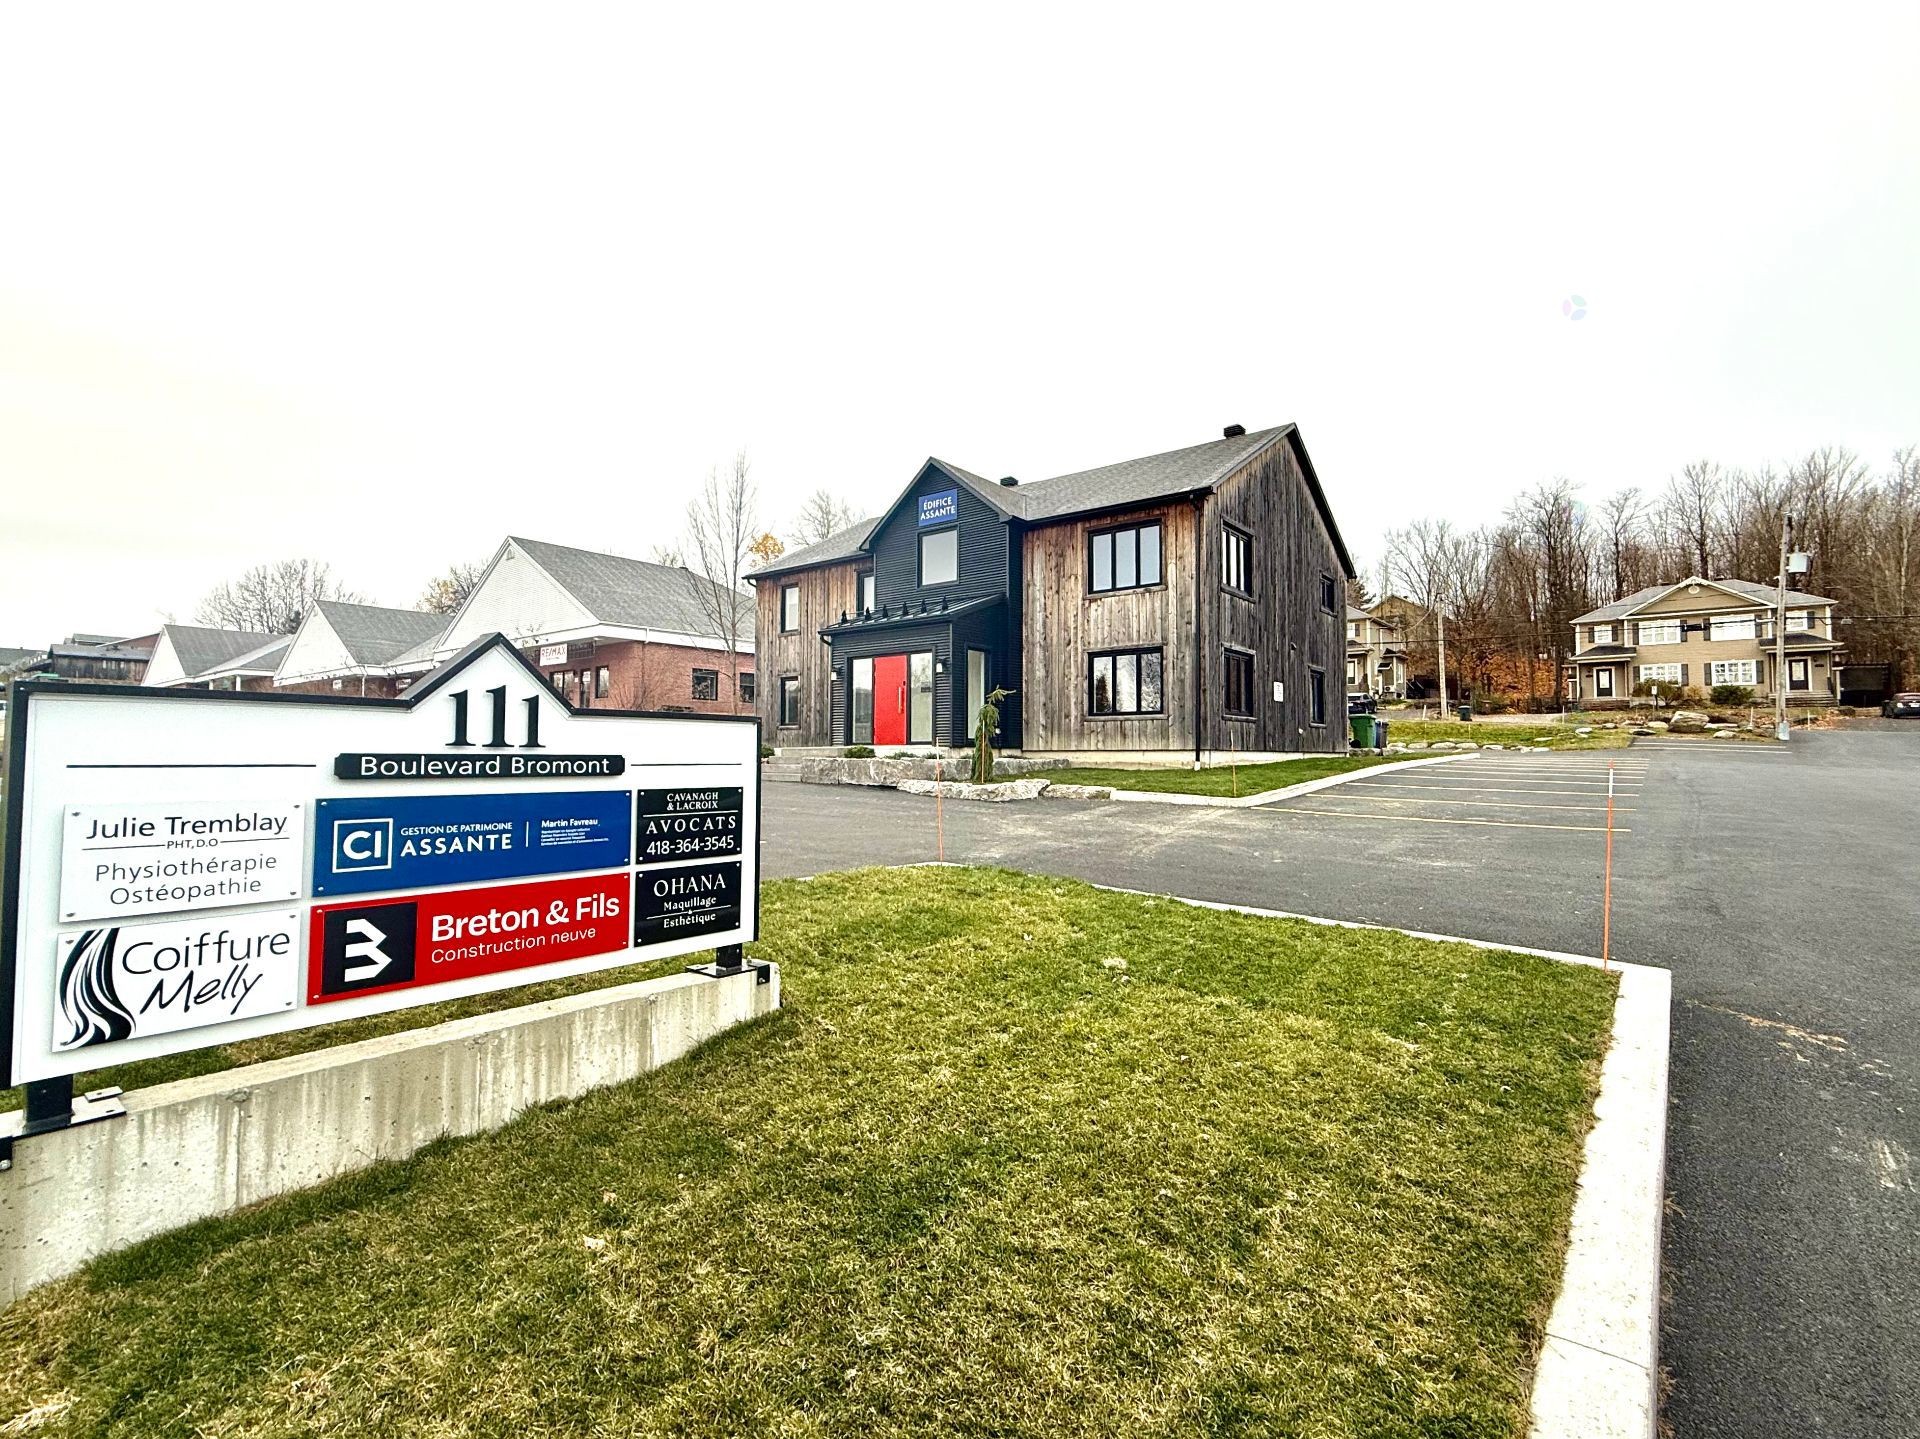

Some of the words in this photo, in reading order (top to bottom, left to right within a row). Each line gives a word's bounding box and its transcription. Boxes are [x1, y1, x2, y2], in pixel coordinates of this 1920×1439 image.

[920, 505, 955, 520] ASSANTE
[923, 497, 952, 510] ÉDIFICE
[445, 684, 546, 748] 111
[361, 756, 500, 776] Boulevard
[511, 757, 610, 774] Bromont
[666, 792, 718, 802] CAVANAGH
[666, 802, 674, 810] &
[676, 801, 718, 810] LACROIX
[86, 817, 155, 839] Julie
[165, 812, 287, 835] Tremblay
[400, 824, 443, 836] GESTION
[445, 824, 458, 834] DE
[460, 822, 513, 833] PATRIMOINE
[541, 820, 568, 828] Martin
[646, 816, 736, 834] AVOCATS
[342, 830, 381, 860] CI
[400, 834, 513, 857] ASSANTE
[646, 835, 734, 855] 418-364-3545
[96, 853, 277, 884] Physiothérapie
[110, 877, 261, 904] Ostéopathie
[654, 873, 726, 896] OHANA
[664, 896, 716, 911] Maquillage
[432, 906, 539, 941] Breton
[546, 901, 569, 924] &
[576, 893, 620, 922] Fils
[664, 914, 716, 928] Esthétique
[122, 929, 290, 975] Coiffure
[431, 936, 545, 964] Construction
[550, 926, 596, 943] neuve
[140, 963, 262, 1015] Melly
